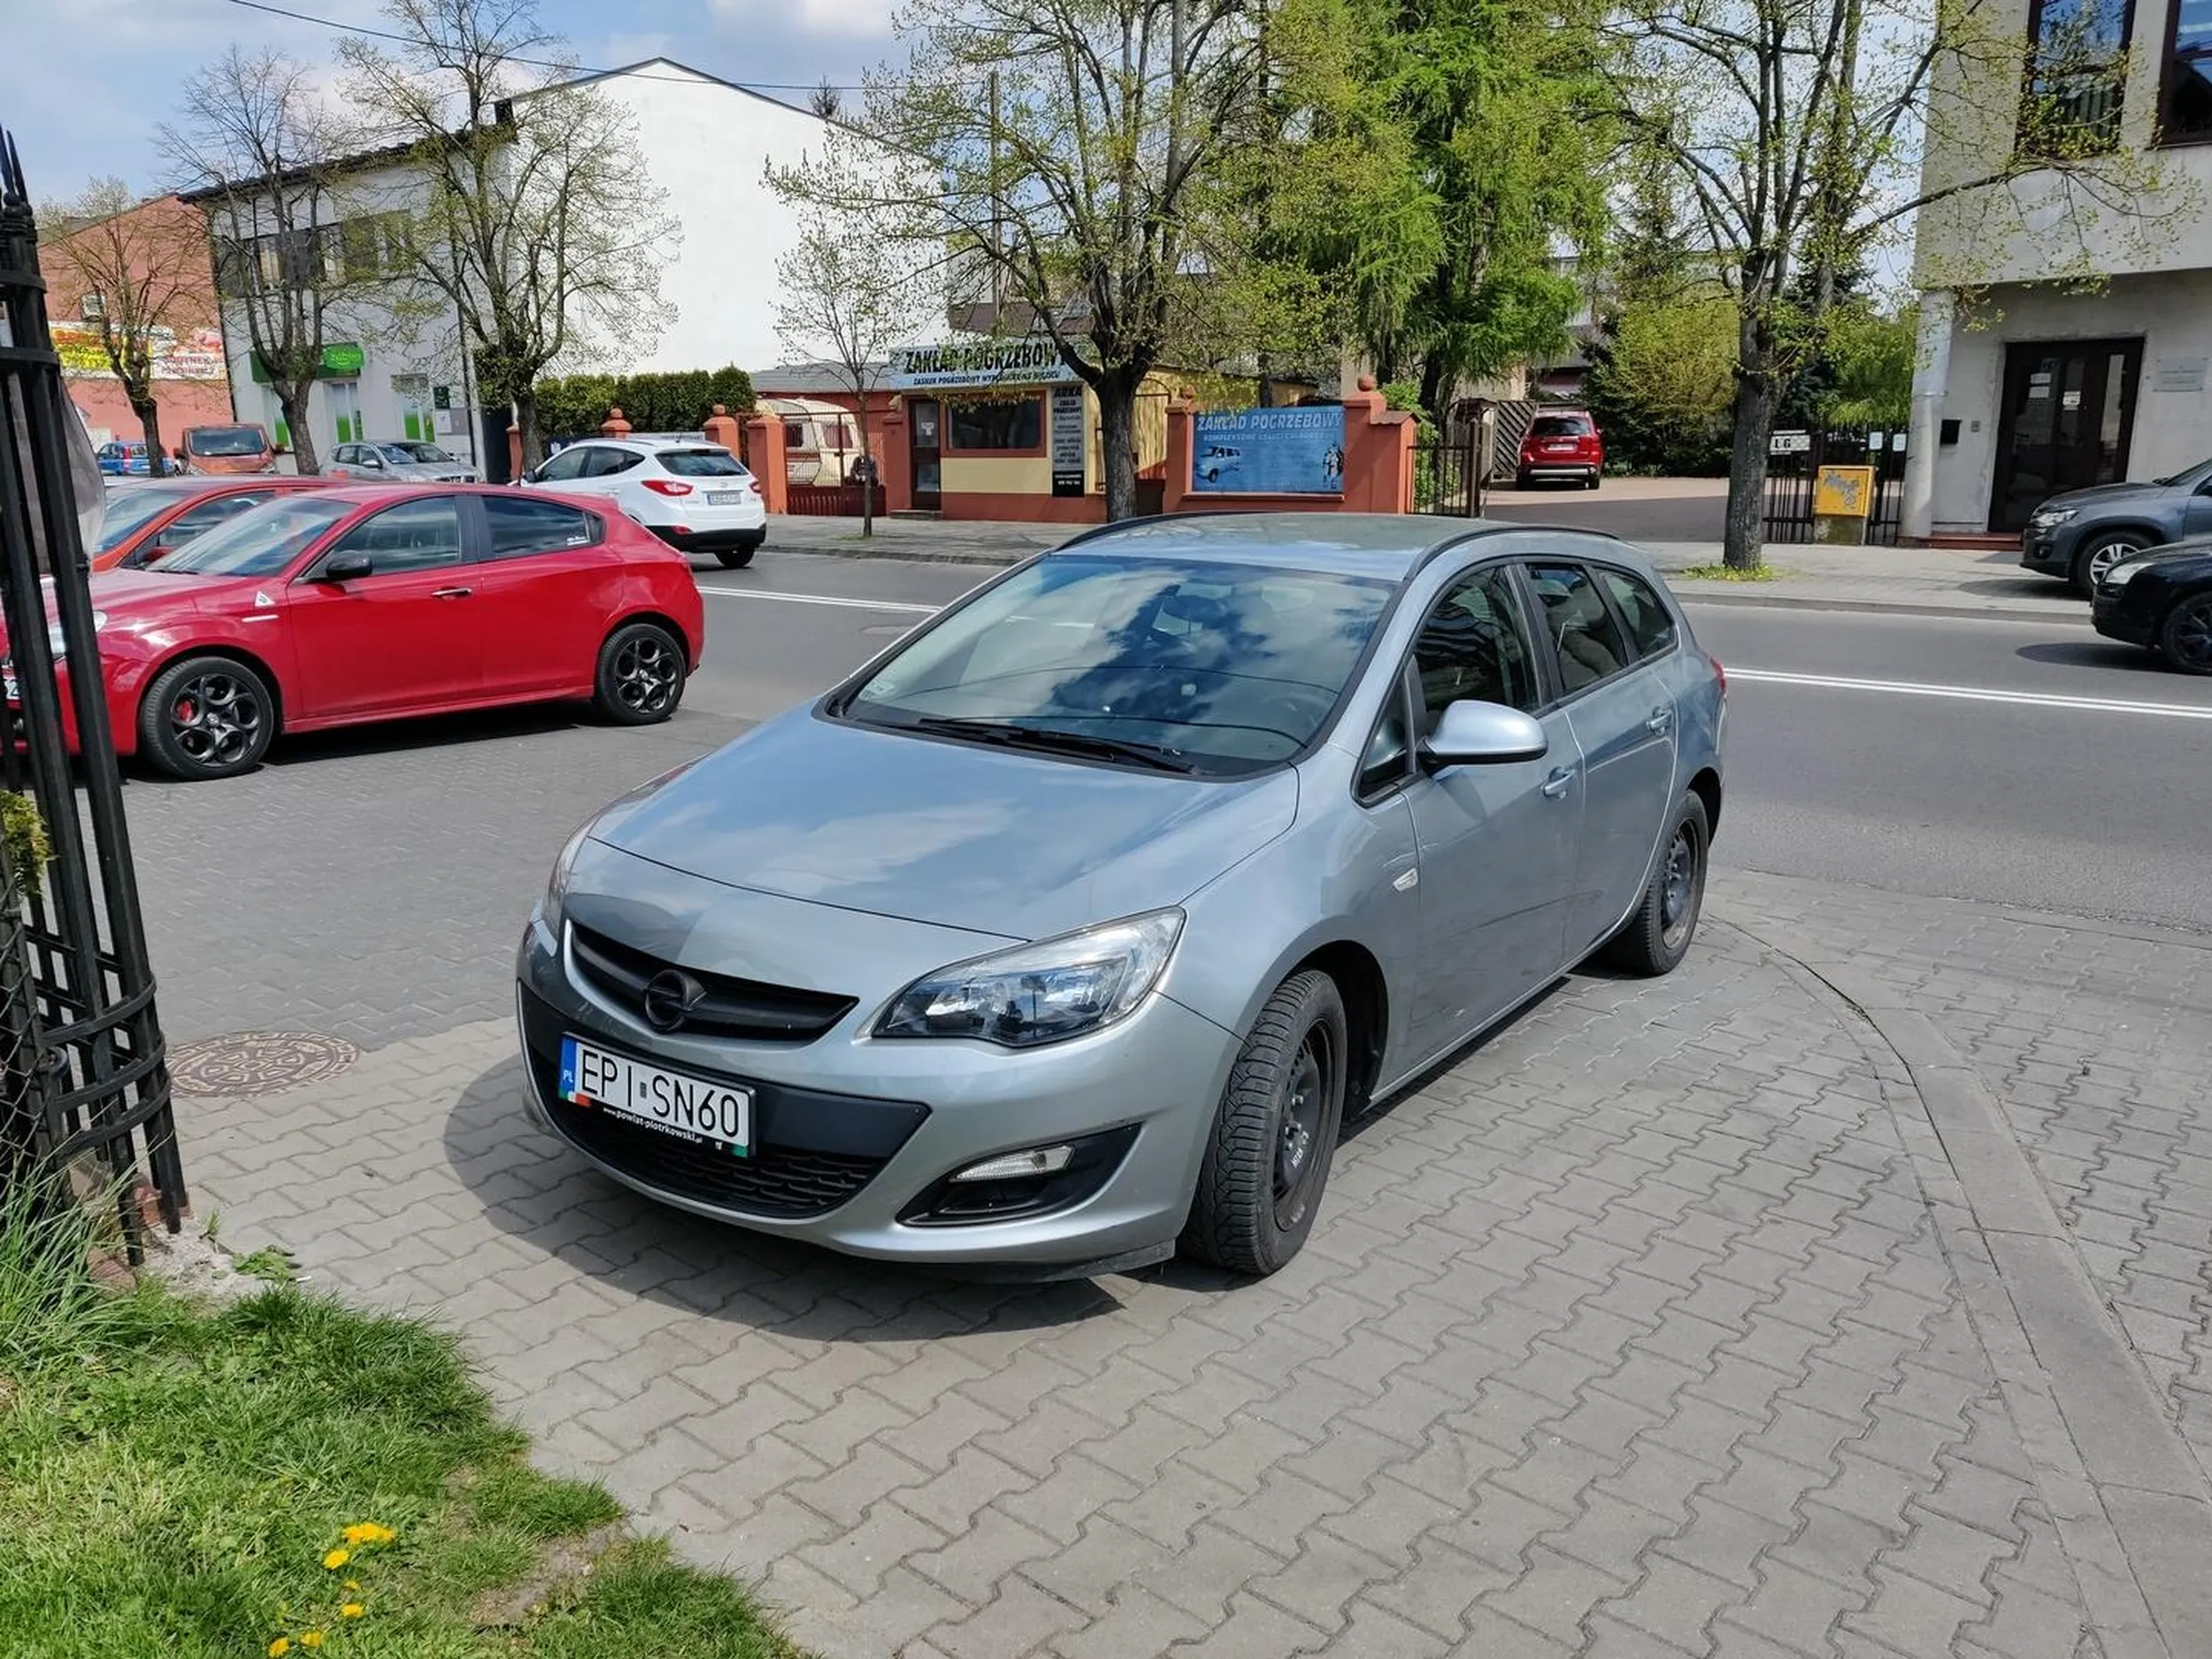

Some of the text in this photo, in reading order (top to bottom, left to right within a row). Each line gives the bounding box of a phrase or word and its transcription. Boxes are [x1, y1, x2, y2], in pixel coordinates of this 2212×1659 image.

[963, 342, 1062, 371] POGRZEBOW
[1197, 412, 1342, 431] ZAKŁAD POGRZEBOWY
[563, 1069, 573, 1083] PL
[581, 1049, 739, 1138] EPI SN60
[603, 1107, 703, 1144] www.powiat-piotrkowski.pl
